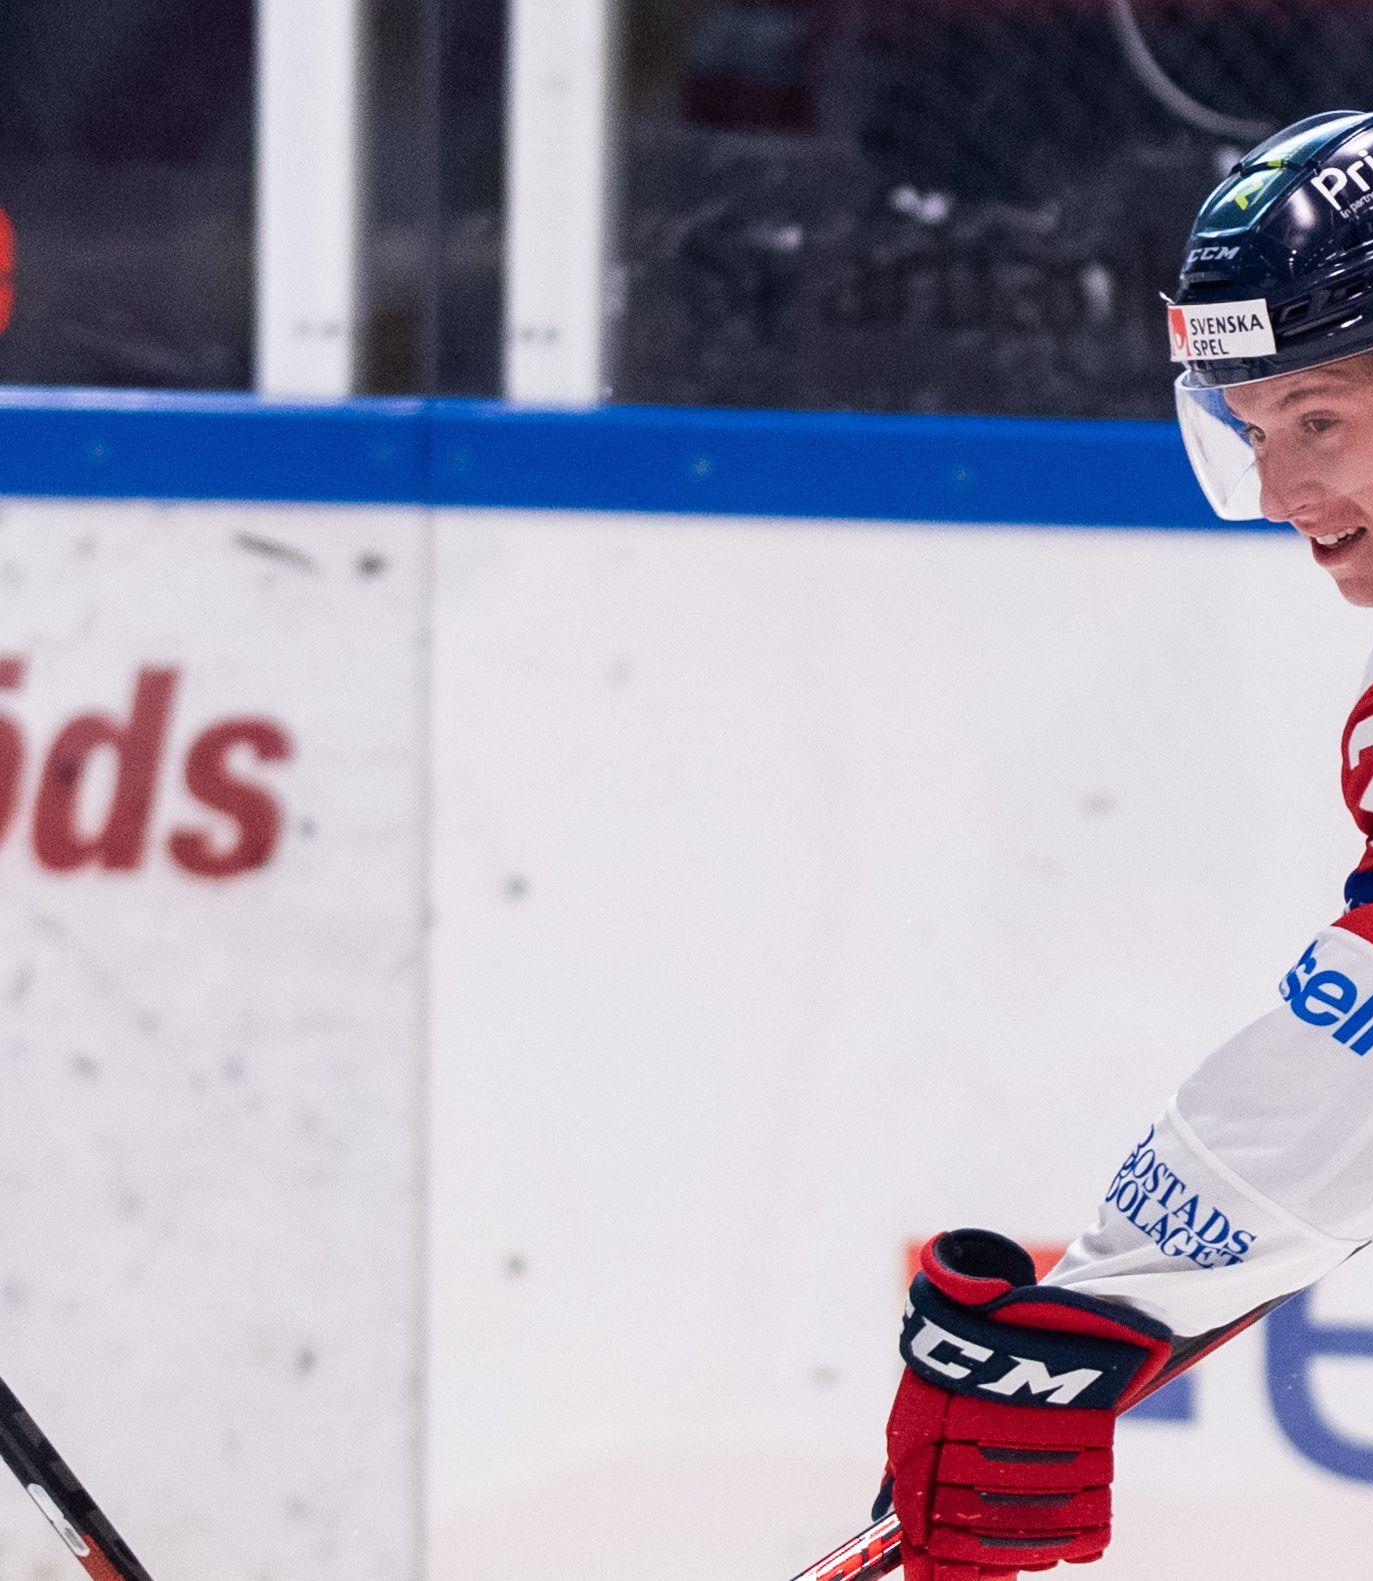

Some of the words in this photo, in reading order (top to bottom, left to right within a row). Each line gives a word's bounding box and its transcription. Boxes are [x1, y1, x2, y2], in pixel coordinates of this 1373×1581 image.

[1186, 246, 1240, 263] CCM
[1190, 313, 1265, 336] SVENSKA
[1193, 339, 1230, 356] SPEL
